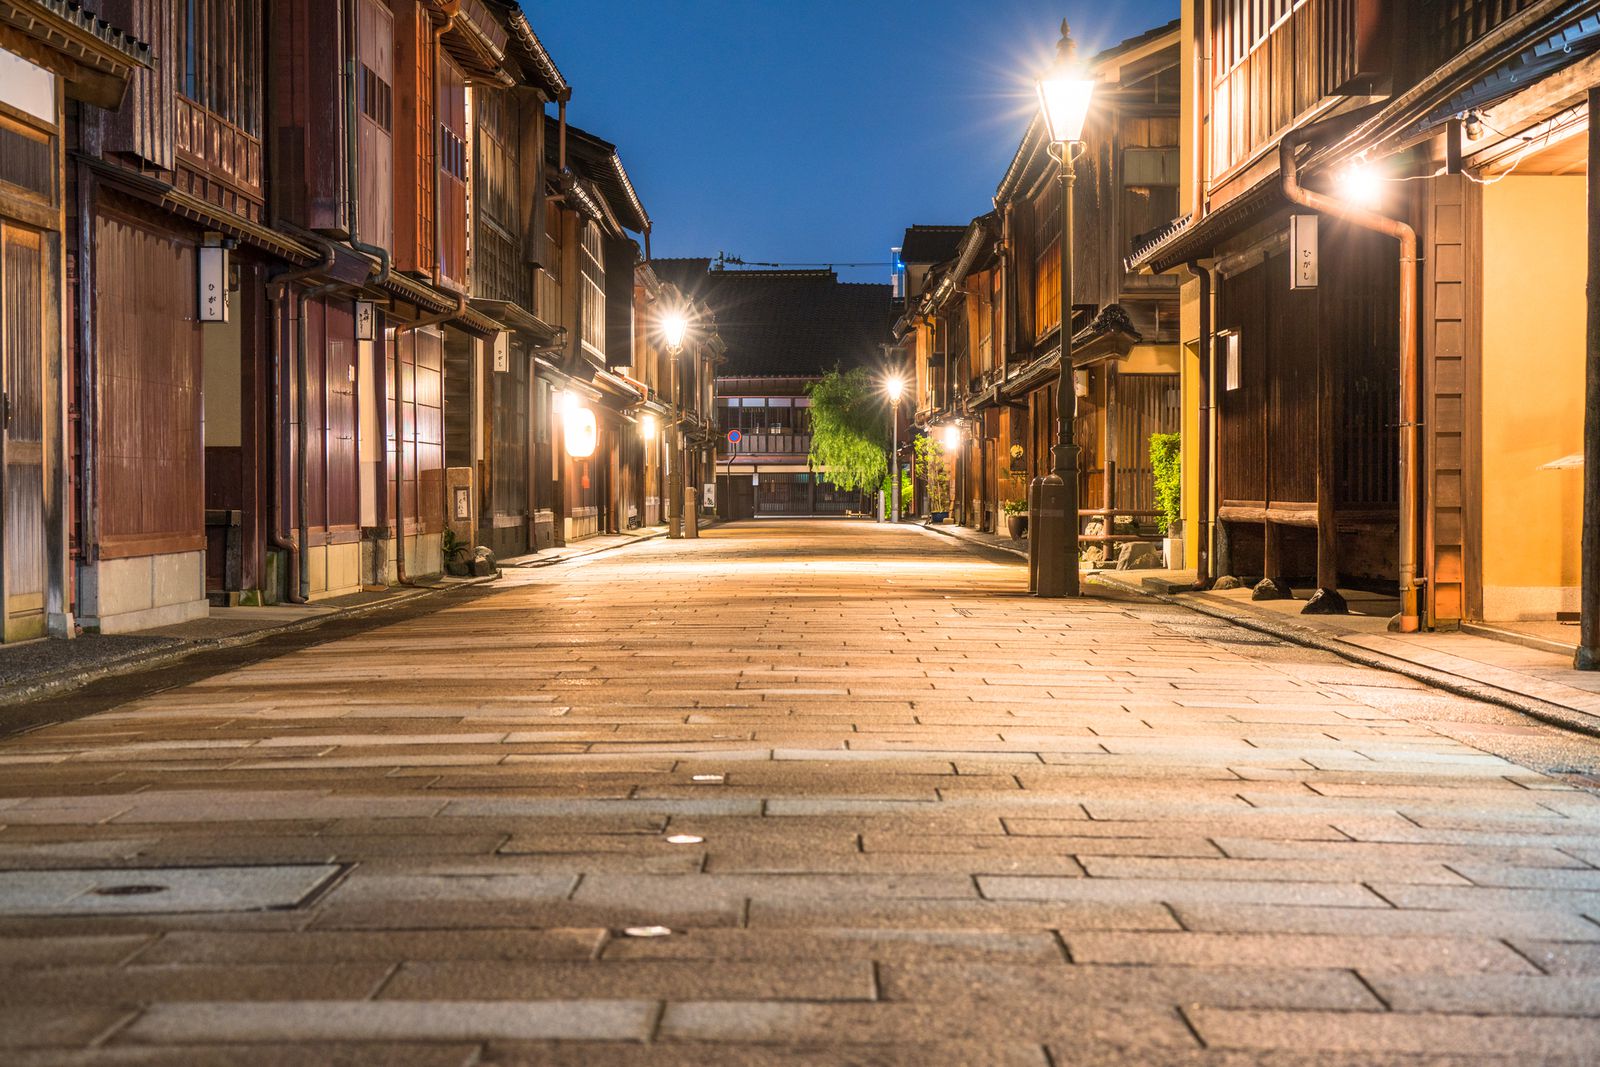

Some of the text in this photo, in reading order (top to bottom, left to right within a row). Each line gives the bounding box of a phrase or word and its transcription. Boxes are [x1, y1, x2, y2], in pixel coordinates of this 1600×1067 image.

[1303, 249, 1311, 281] ひがし
[208, 283, 216, 316] ひがし
